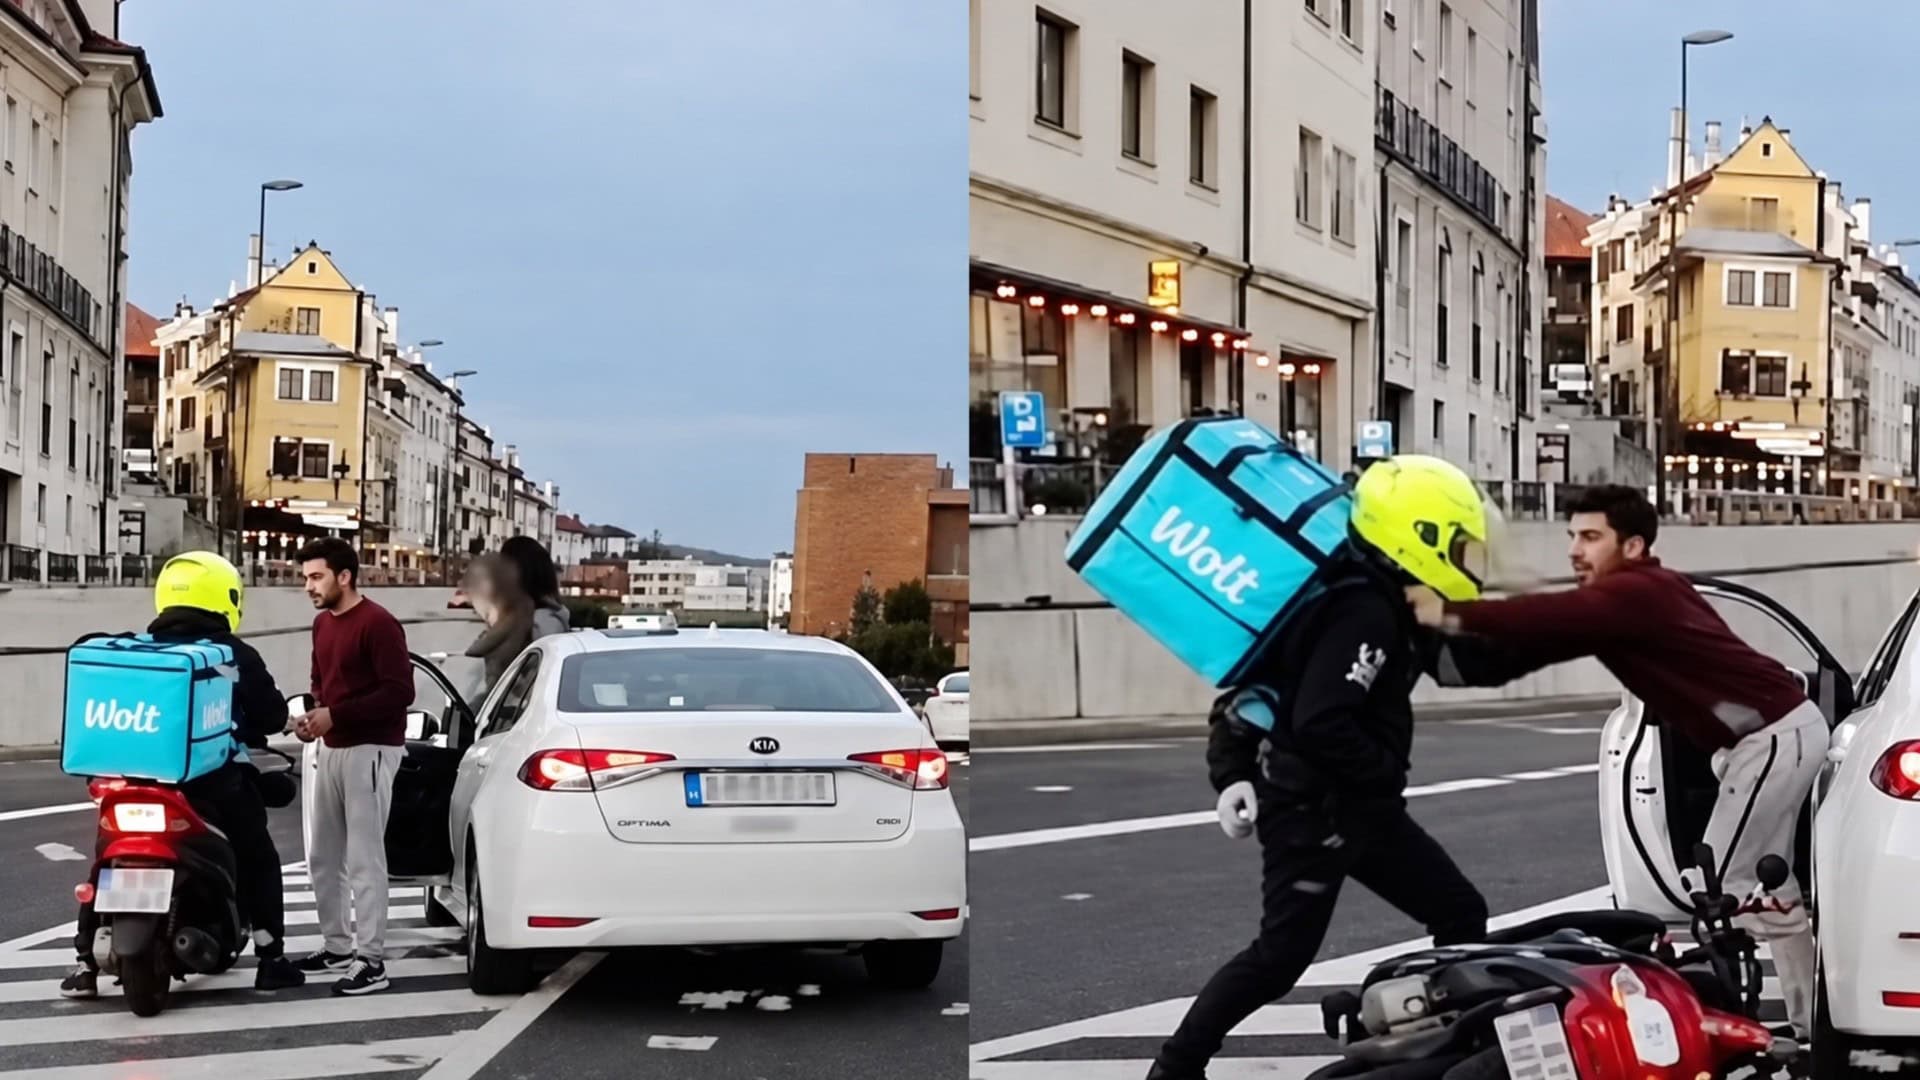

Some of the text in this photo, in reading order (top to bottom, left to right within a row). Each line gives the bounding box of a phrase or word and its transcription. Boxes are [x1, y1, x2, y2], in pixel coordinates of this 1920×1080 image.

[1151, 505, 1259, 605] Wolt
[84, 698, 161, 733] Wolt
[753, 740, 777, 751] KIA
